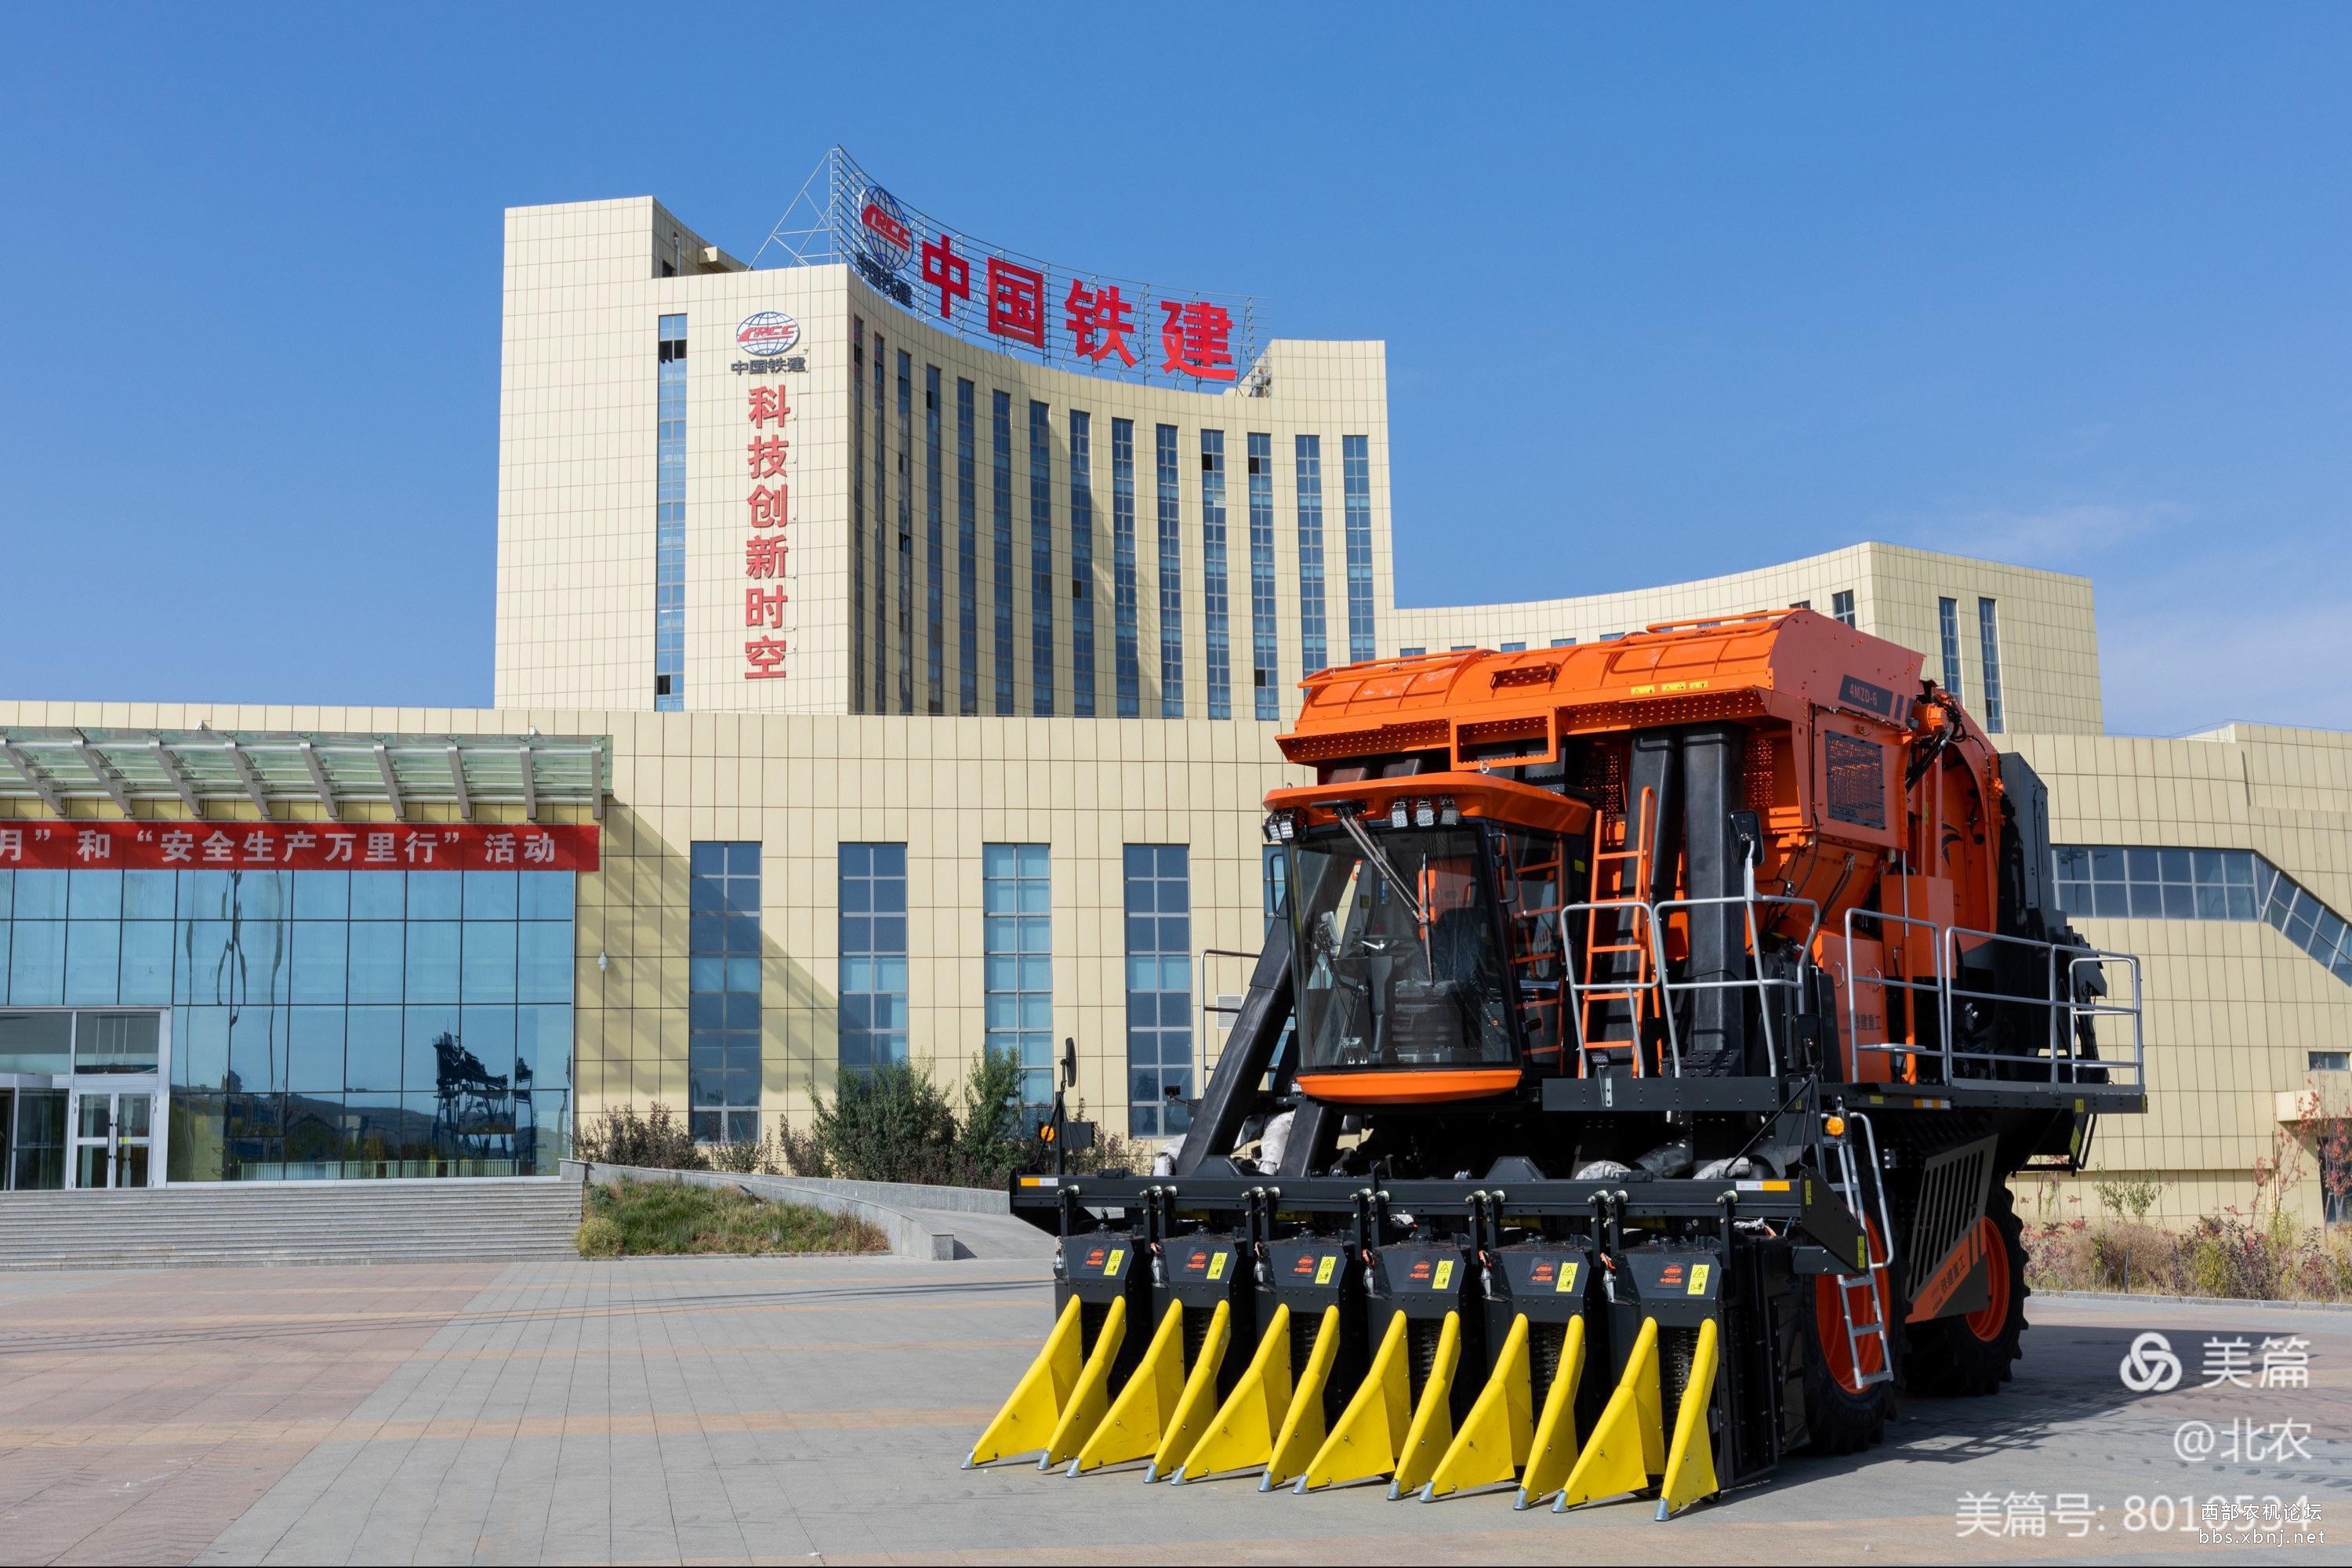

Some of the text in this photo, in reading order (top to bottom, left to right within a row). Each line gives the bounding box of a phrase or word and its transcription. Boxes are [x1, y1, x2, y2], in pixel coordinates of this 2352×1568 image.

[856, 251, 913, 309] 中国铁建
[922, 234, 1237, 381] 中国铁建
[731, 357, 806, 376] 中国铁建
[744, 384, 791, 680] 科技创新时空
[1849, 684, 1878, 706] 4MZD-6
[77, 829, 111, 862] 和
[136, 829, 459, 863] “安全生产万里行”
[484, 831, 555, 863] 活动
